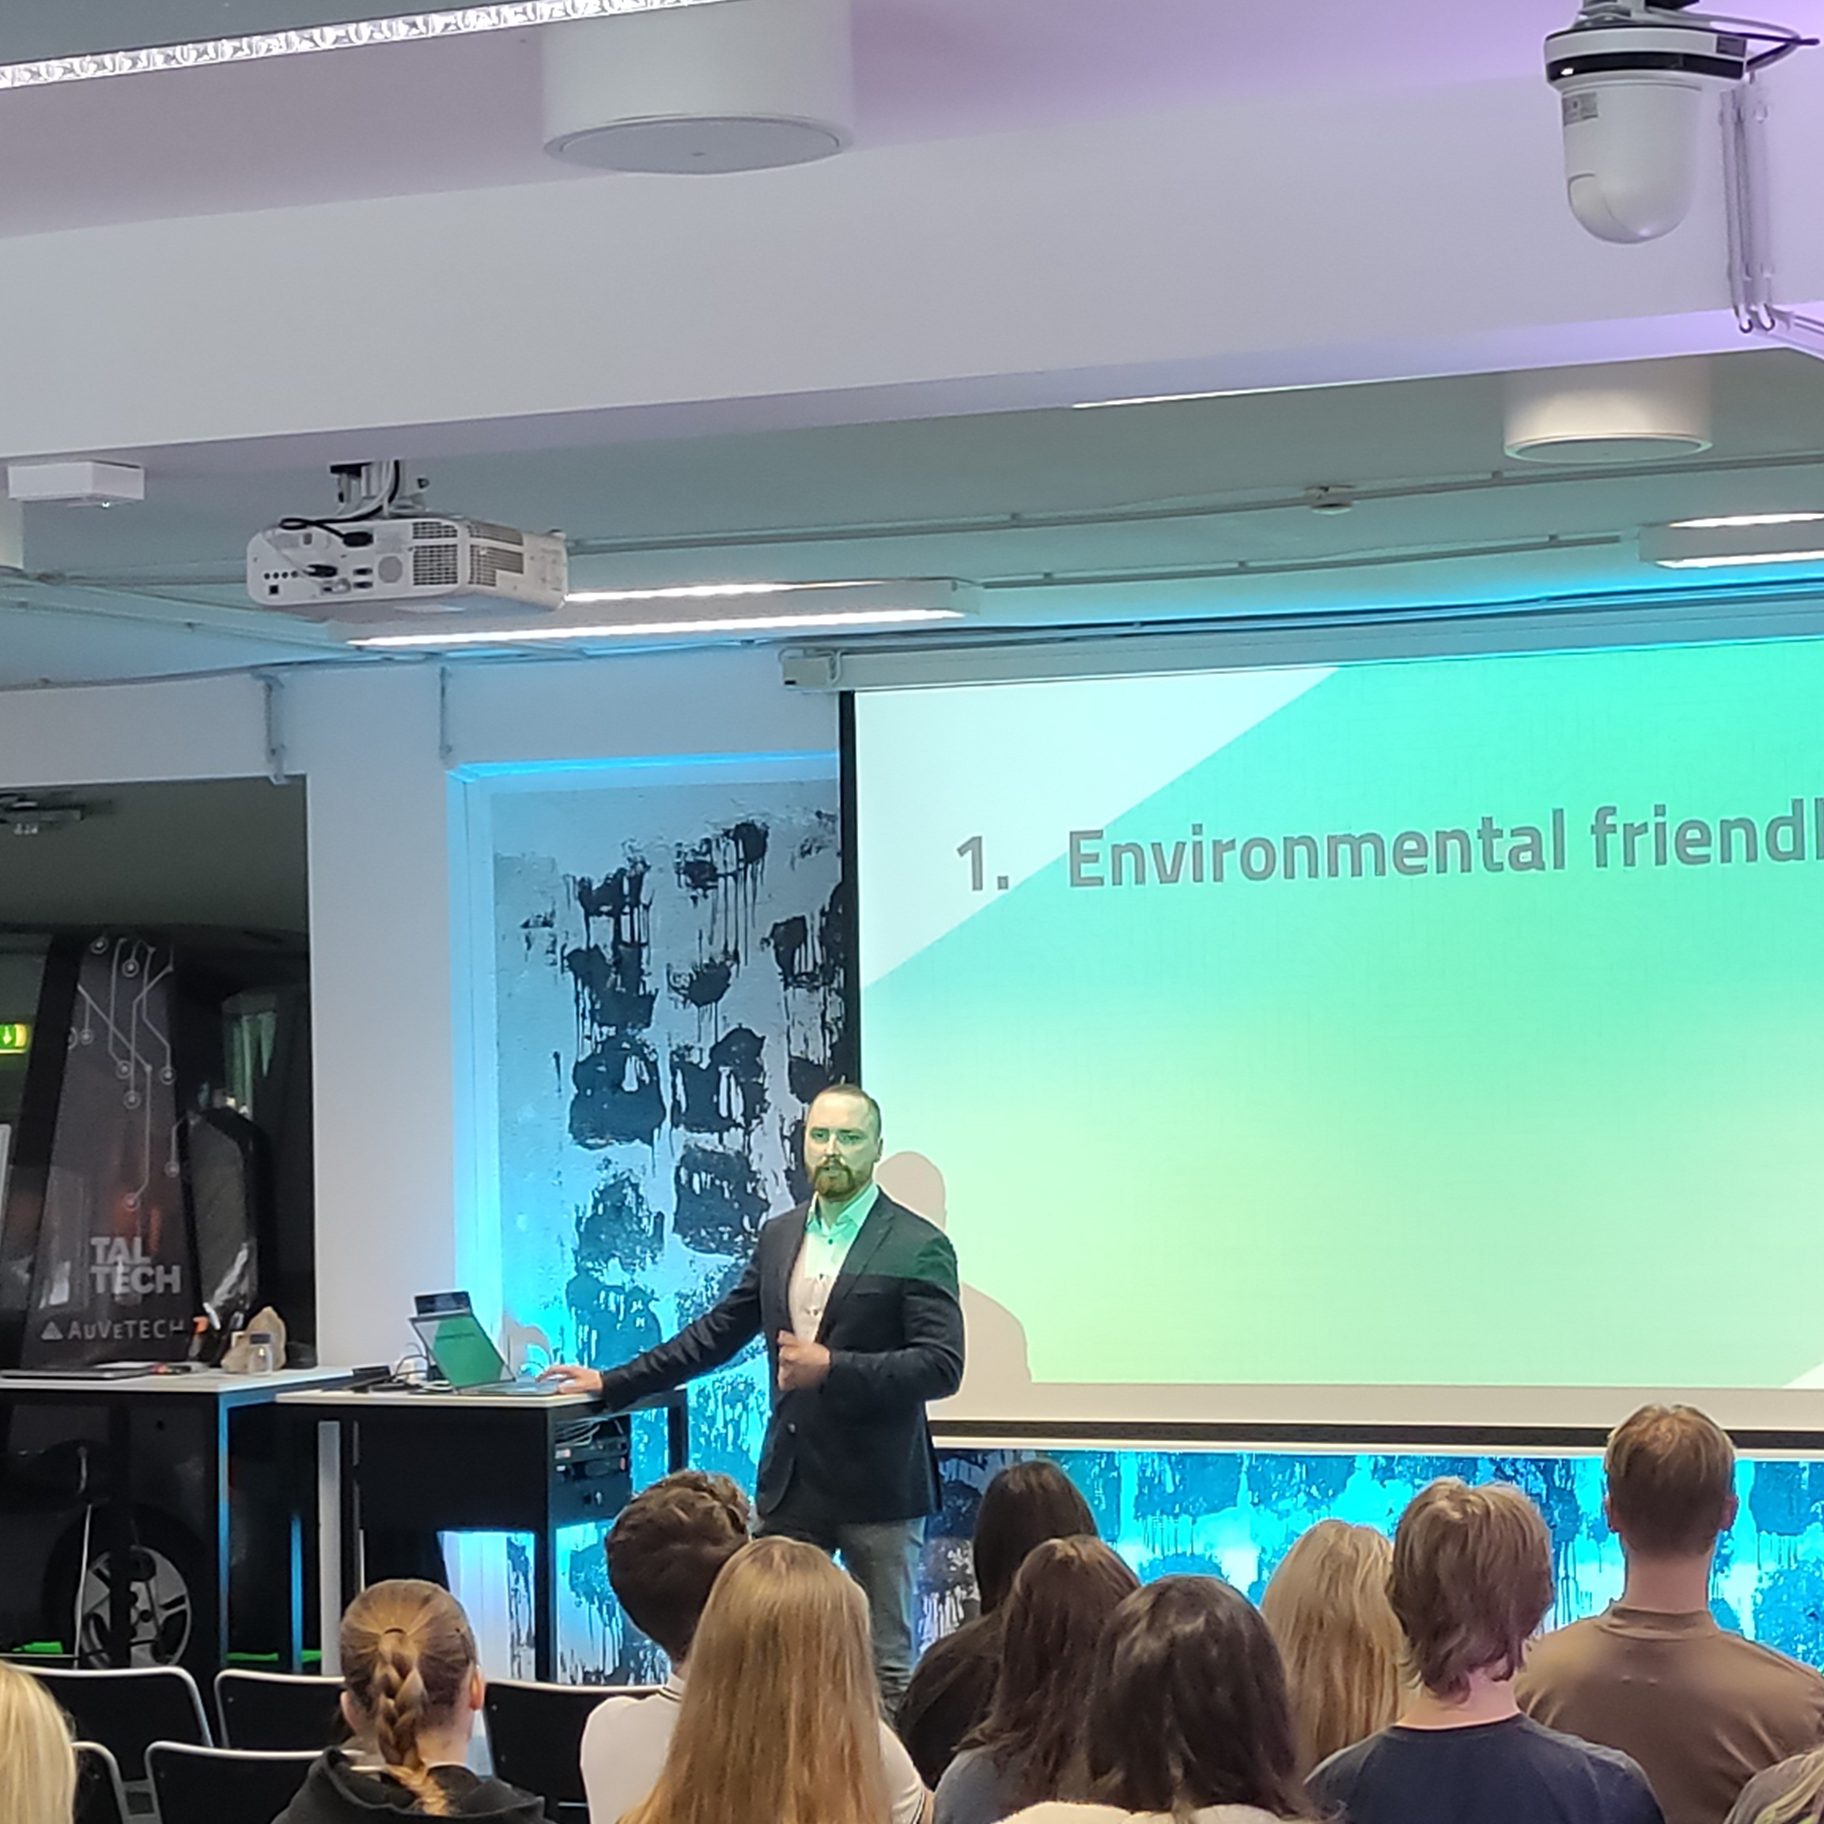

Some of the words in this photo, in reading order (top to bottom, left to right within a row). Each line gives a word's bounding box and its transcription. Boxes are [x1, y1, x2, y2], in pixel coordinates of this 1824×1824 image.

[956, 835, 1010, 891] 1.
[1068, 808, 1566, 888] Environmental
[90, 1236, 152, 1265] TAL
[90, 1264, 182, 1294] TECH
